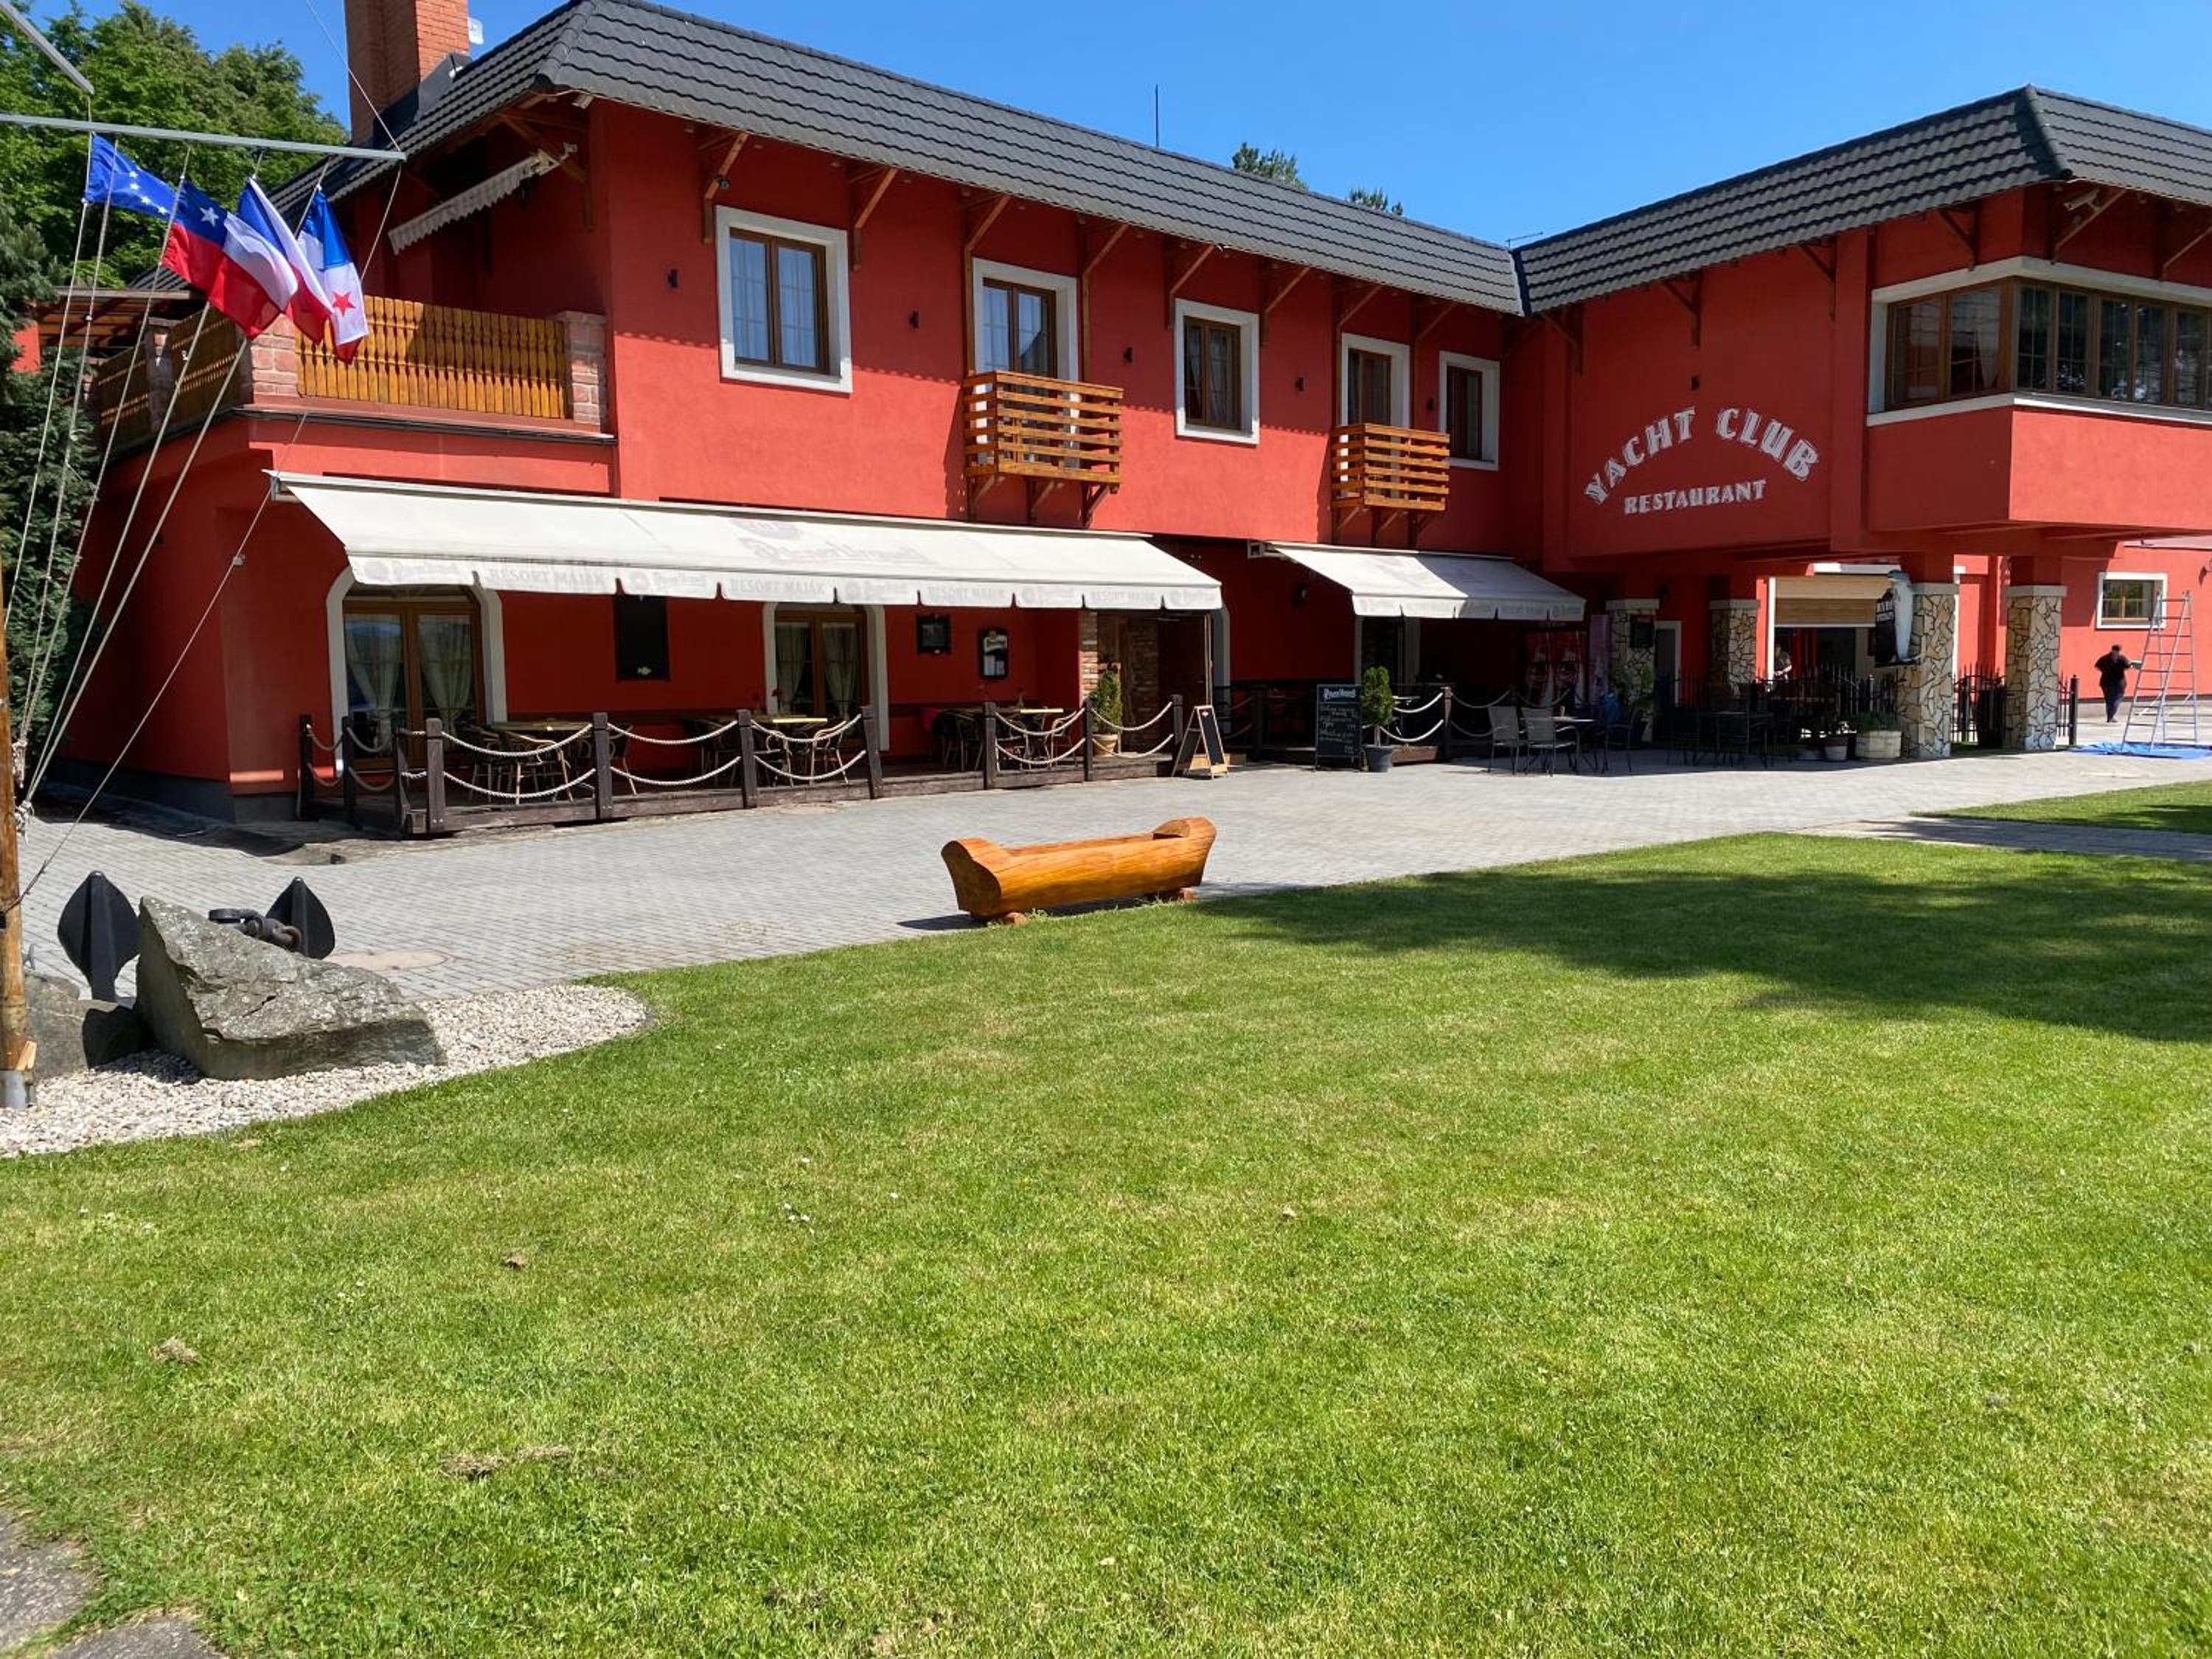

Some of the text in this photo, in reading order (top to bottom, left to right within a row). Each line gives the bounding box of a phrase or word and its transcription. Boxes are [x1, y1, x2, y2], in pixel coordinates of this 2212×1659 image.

[1585, 406, 1820, 506] YACHT CLUB
[1624, 479, 1767, 515] RESTAURANT
